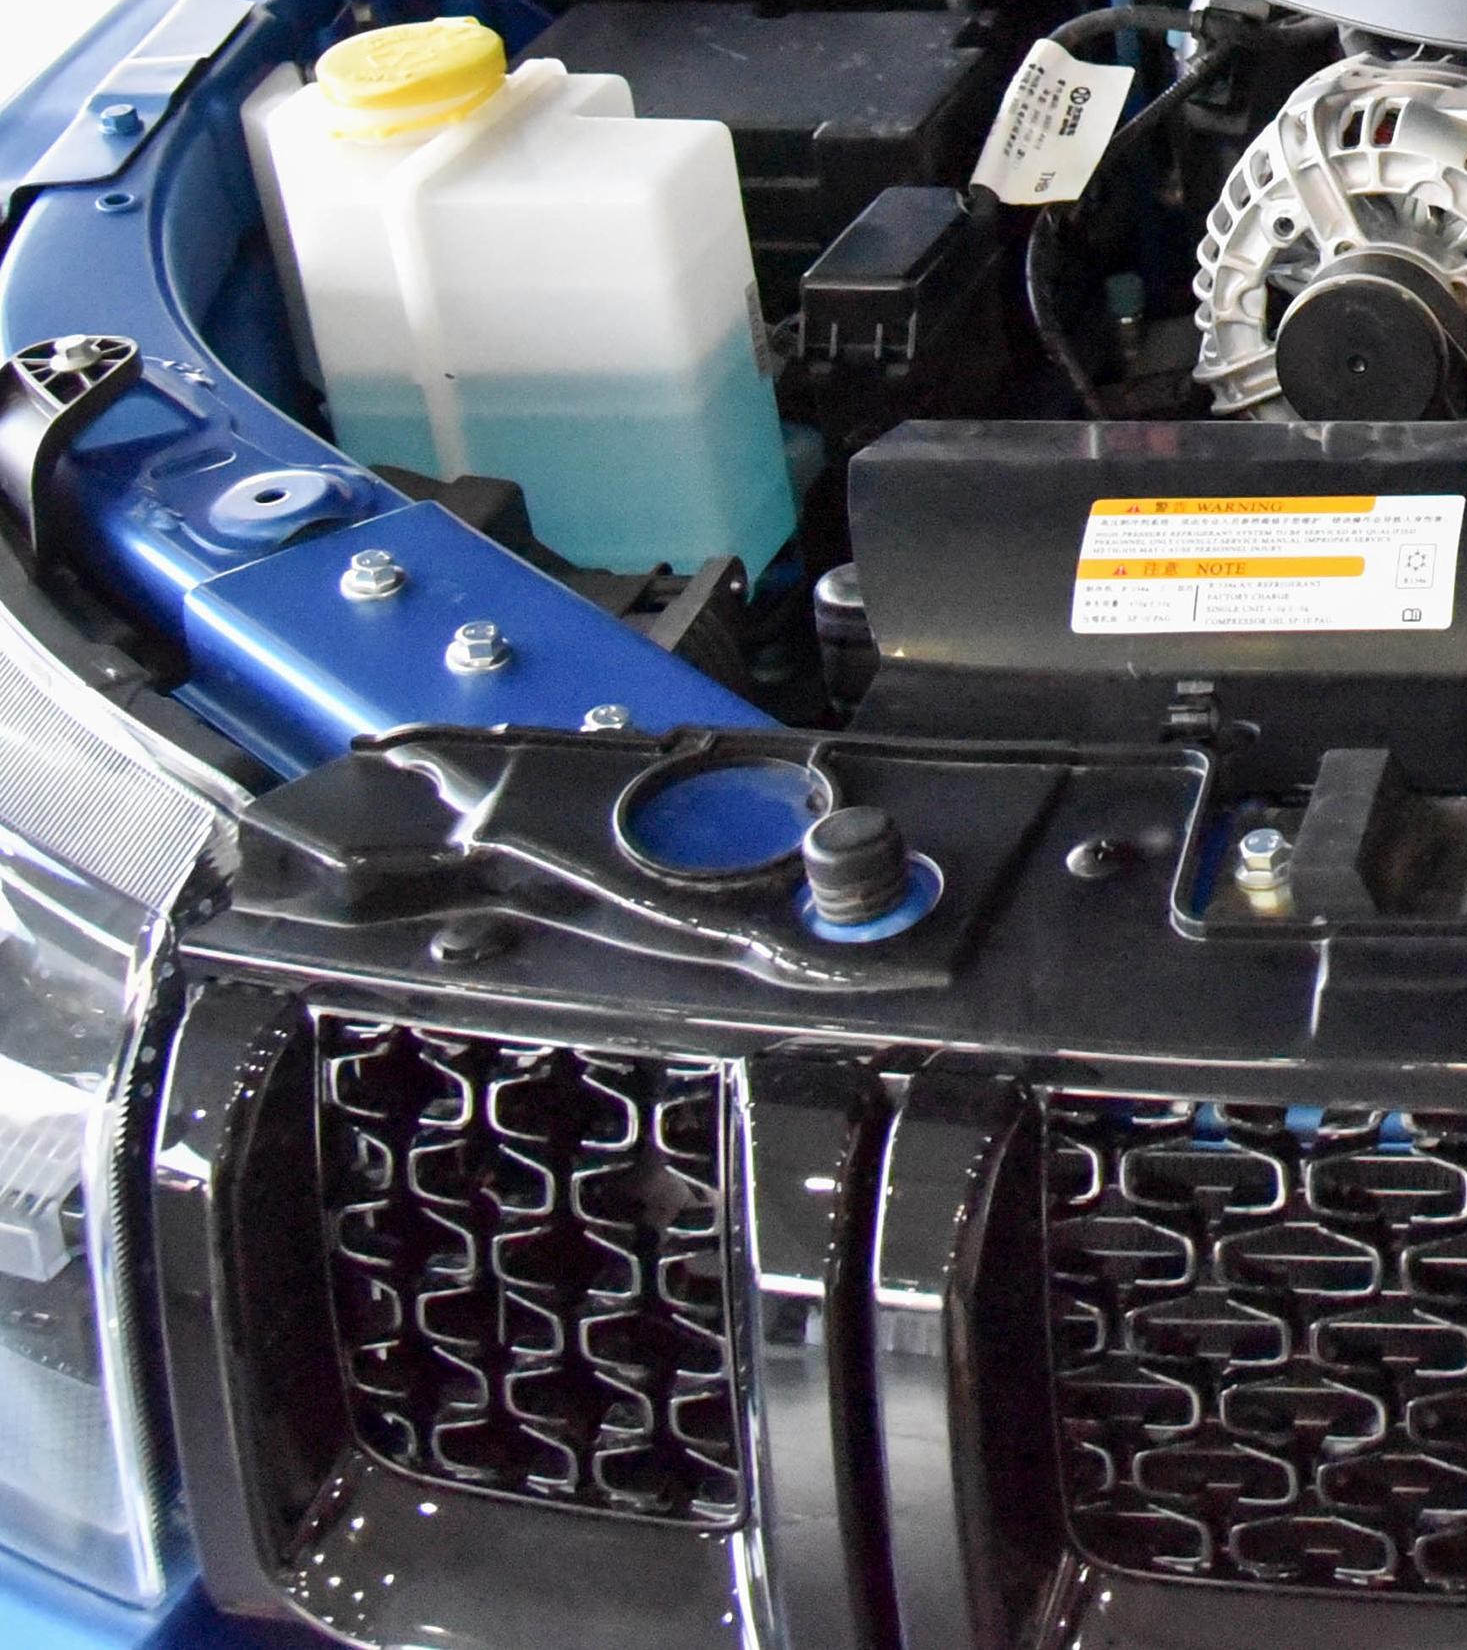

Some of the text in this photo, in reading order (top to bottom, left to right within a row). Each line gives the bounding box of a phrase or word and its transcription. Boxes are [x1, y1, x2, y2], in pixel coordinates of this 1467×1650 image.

[1197, 501, 1284, 513] WARNING
[1143, 561, 1248, 576] 注意 NOTE
